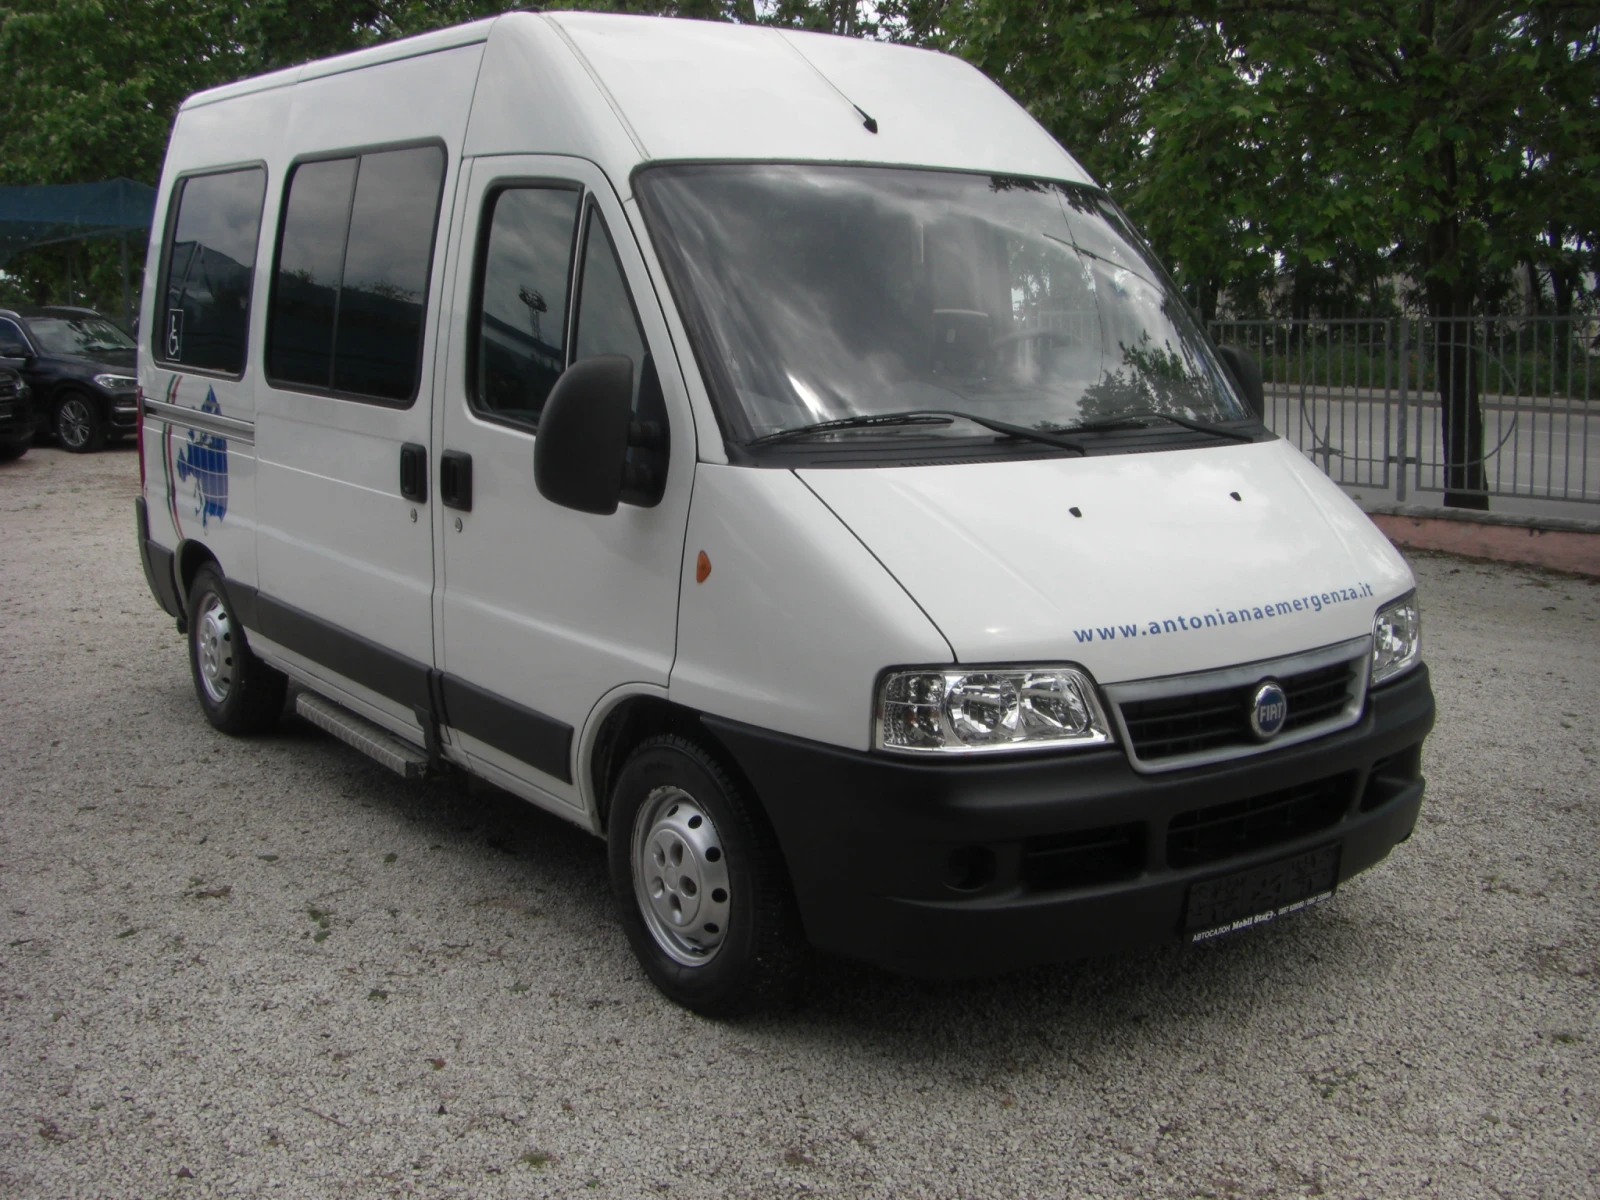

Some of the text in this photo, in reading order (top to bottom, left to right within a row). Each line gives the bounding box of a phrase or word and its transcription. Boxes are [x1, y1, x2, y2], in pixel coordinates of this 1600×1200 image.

[1073, 582, 1374, 643] www.antonianaemergenza.it
[1259, 702, 1283, 723] FIAT
[1192, 925, 1231, 942] АВТОСАЛОН
